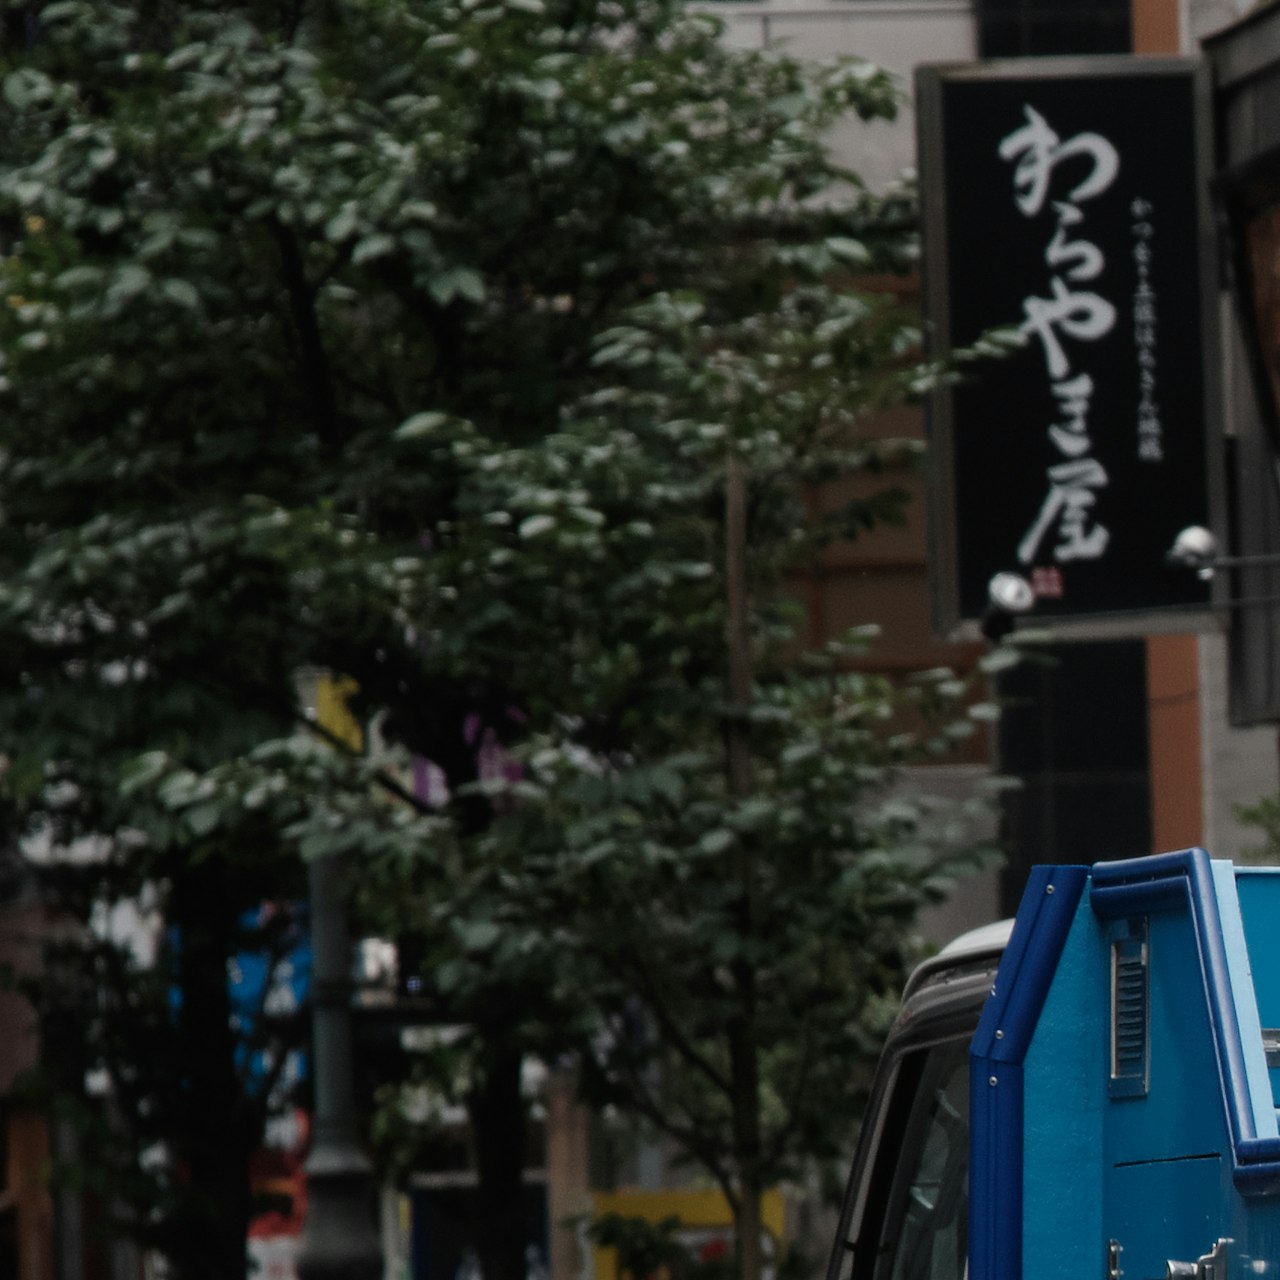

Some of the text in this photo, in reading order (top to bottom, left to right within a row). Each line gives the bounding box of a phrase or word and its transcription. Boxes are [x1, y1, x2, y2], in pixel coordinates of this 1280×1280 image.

[997, 104, 1120, 563] わらやき屋
